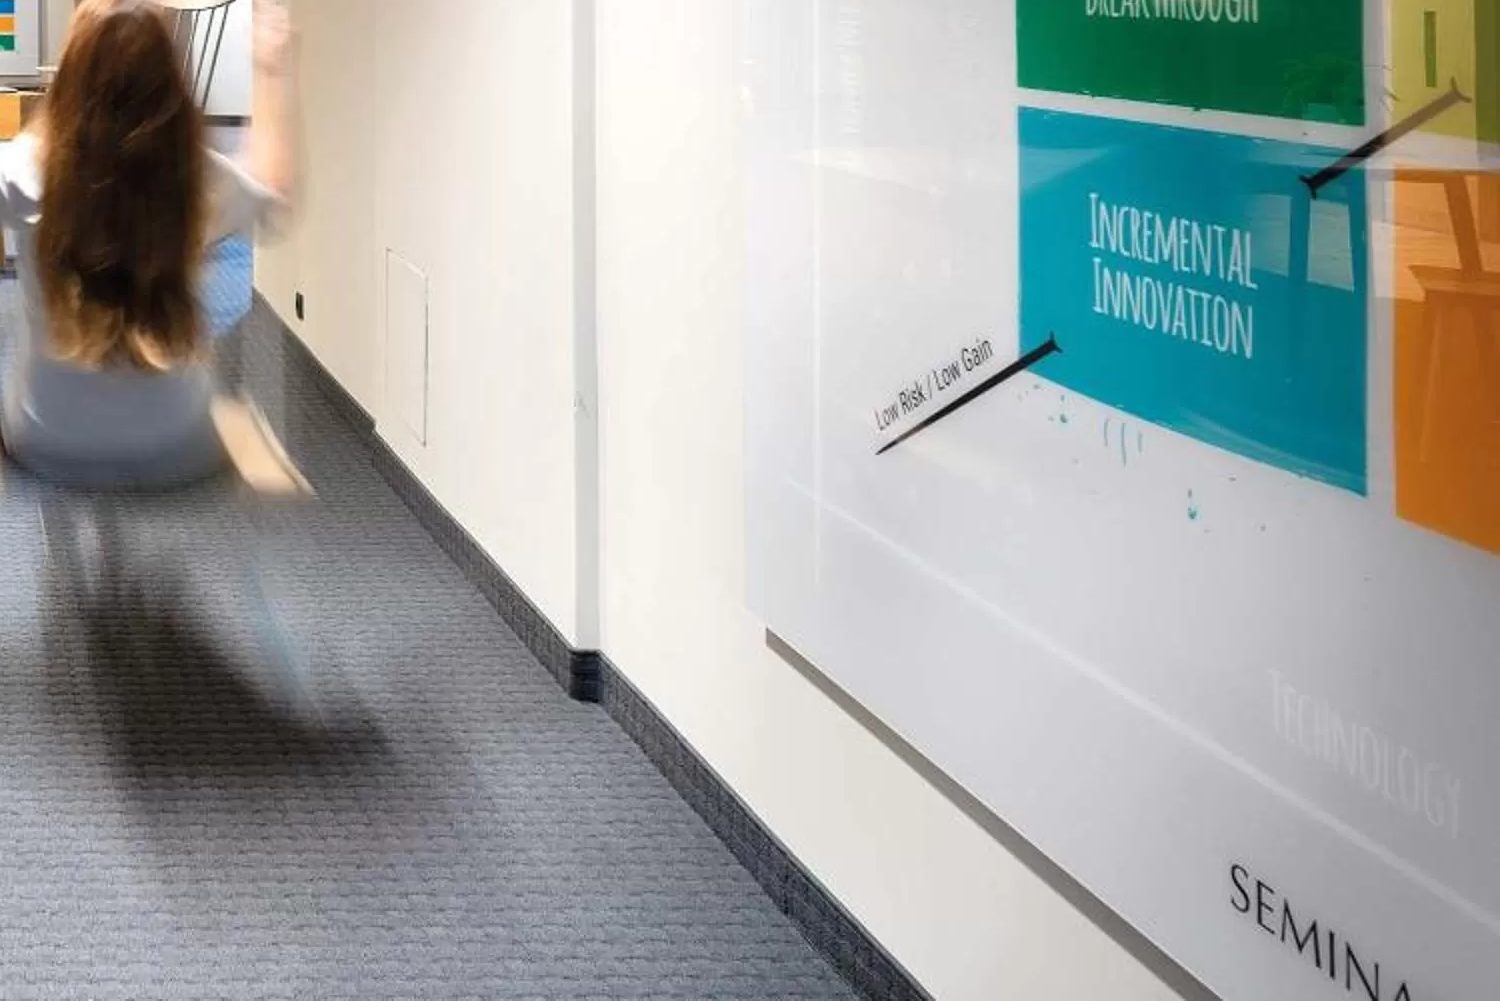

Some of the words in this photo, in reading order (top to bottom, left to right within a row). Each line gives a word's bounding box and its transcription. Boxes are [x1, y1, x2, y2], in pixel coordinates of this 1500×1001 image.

[1088, 192, 1259, 290] INCREMENTAL
[1092, 256, 1253, 360] INNOVATION
[874, 402, 899, 431] Low
[899, 379, 928, 415] Risk
[932, 360, 961, 391] Low
[961, 337, 994, 372] Gain
